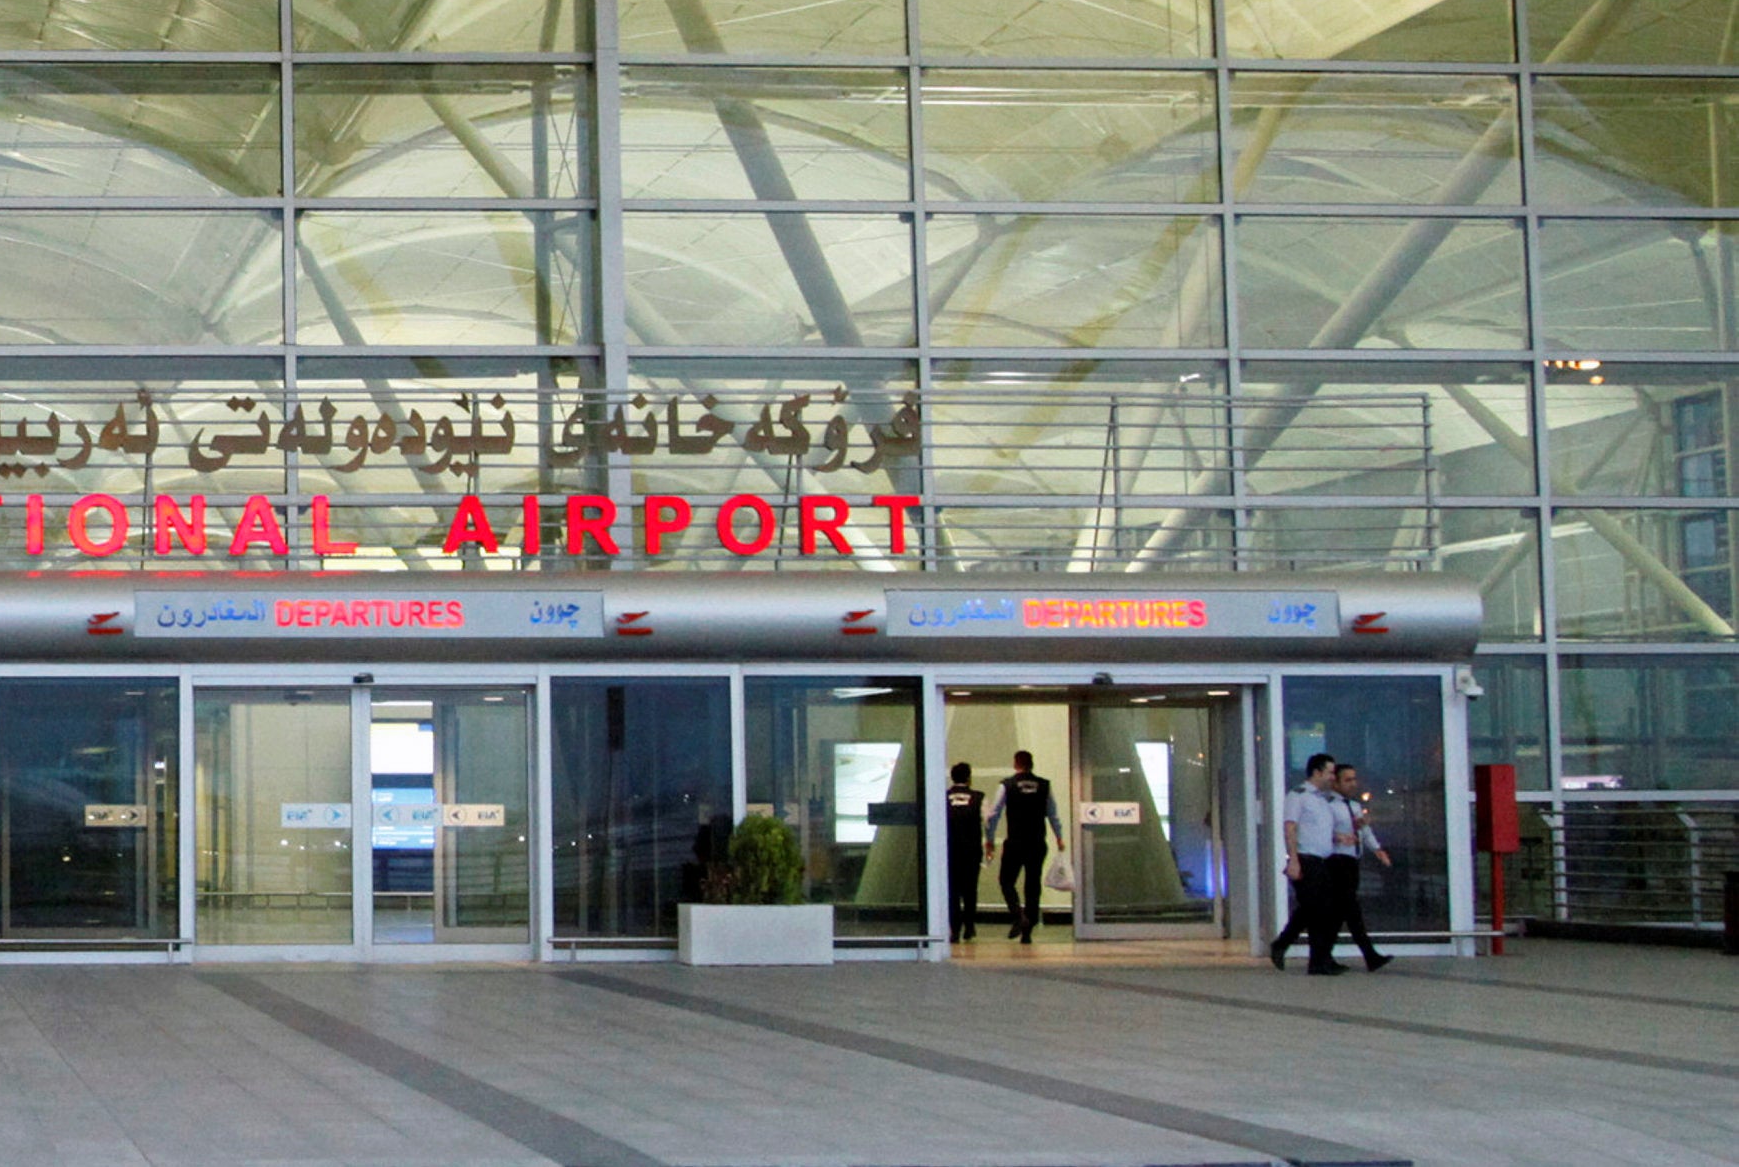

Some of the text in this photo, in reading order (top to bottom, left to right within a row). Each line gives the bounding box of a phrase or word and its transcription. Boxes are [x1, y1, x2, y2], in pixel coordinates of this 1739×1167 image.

[442, 493, 921, 555] AIRPORT
[156, 599, 267, 629] المغادرون
[274, 599, 465, 627] DEPARTURES
[1022, 598, 1208, 628] DEPARTURES
